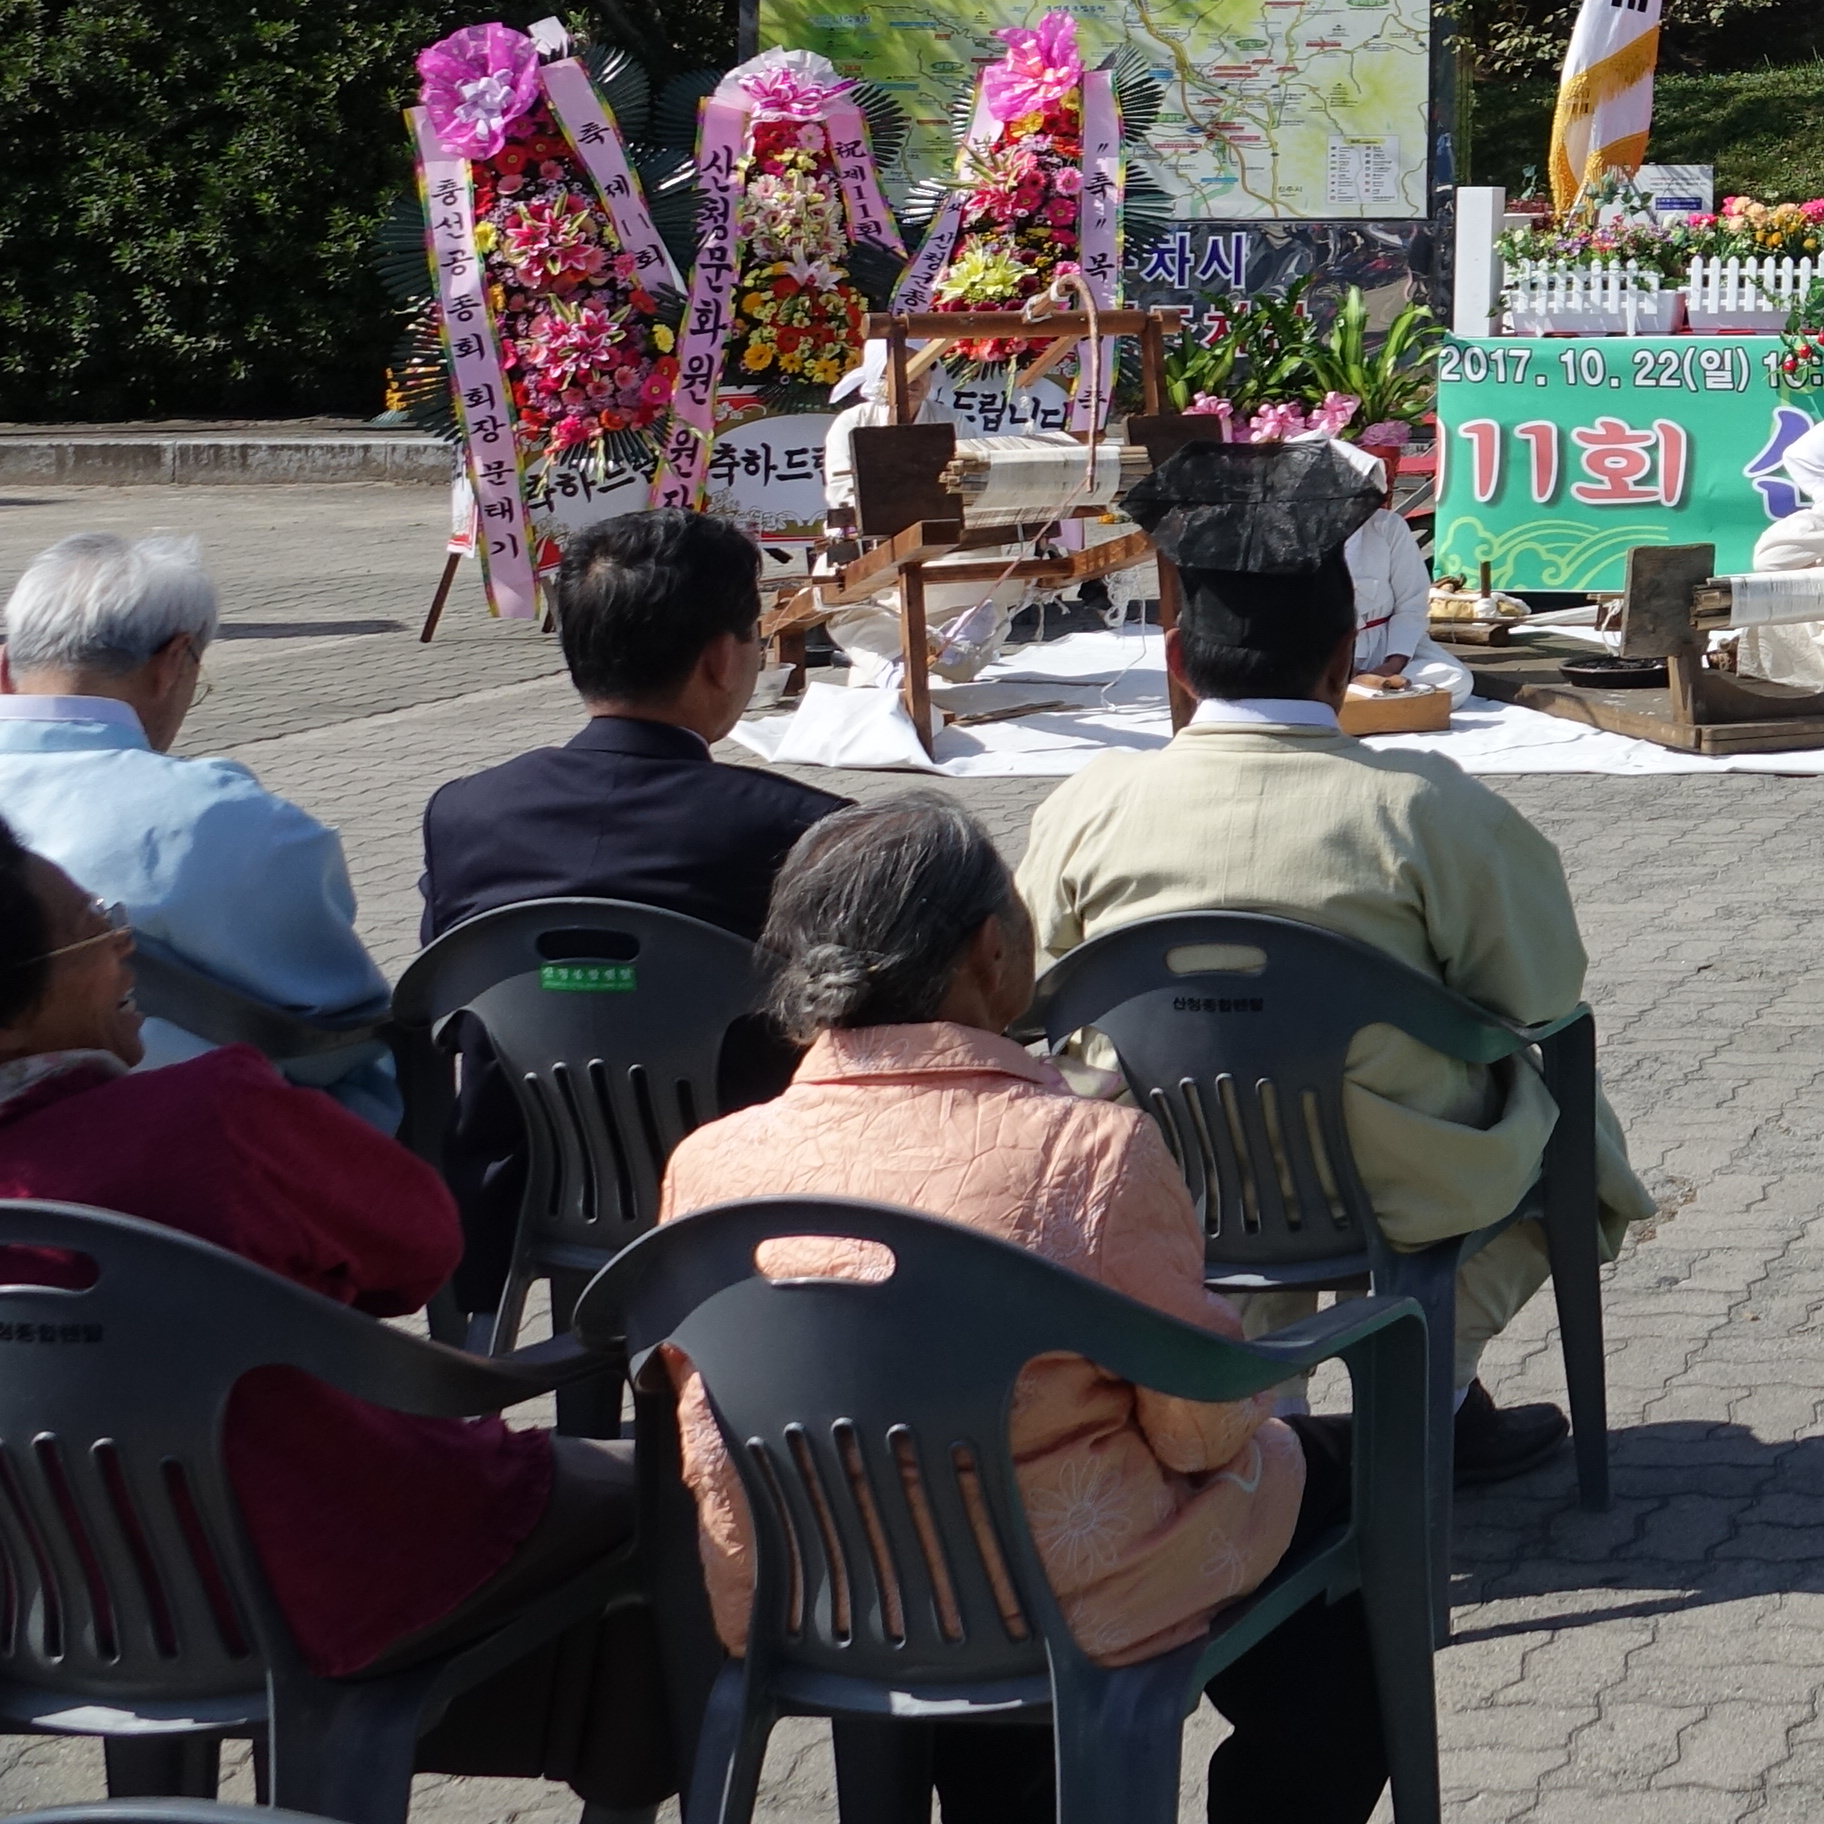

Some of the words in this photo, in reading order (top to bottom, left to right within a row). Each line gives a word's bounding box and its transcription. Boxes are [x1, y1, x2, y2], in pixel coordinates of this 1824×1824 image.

[577, 121, 611, 145] 축
[834, 138, 868, 160] 祝
[679, 143, 734, 407] 산청문화원
[1127, 231, 1249, 290] 차시
[1438, 343, 1546, 388] 2017.
[1558, 346, 1622, 389] 10.
[1631, 345, 1751, 393] 22(일)
[463, 382, 507, 444] 회장
[526, 460, 656, 514] 축하드
[1436, 415, 1690, 509] 11회
